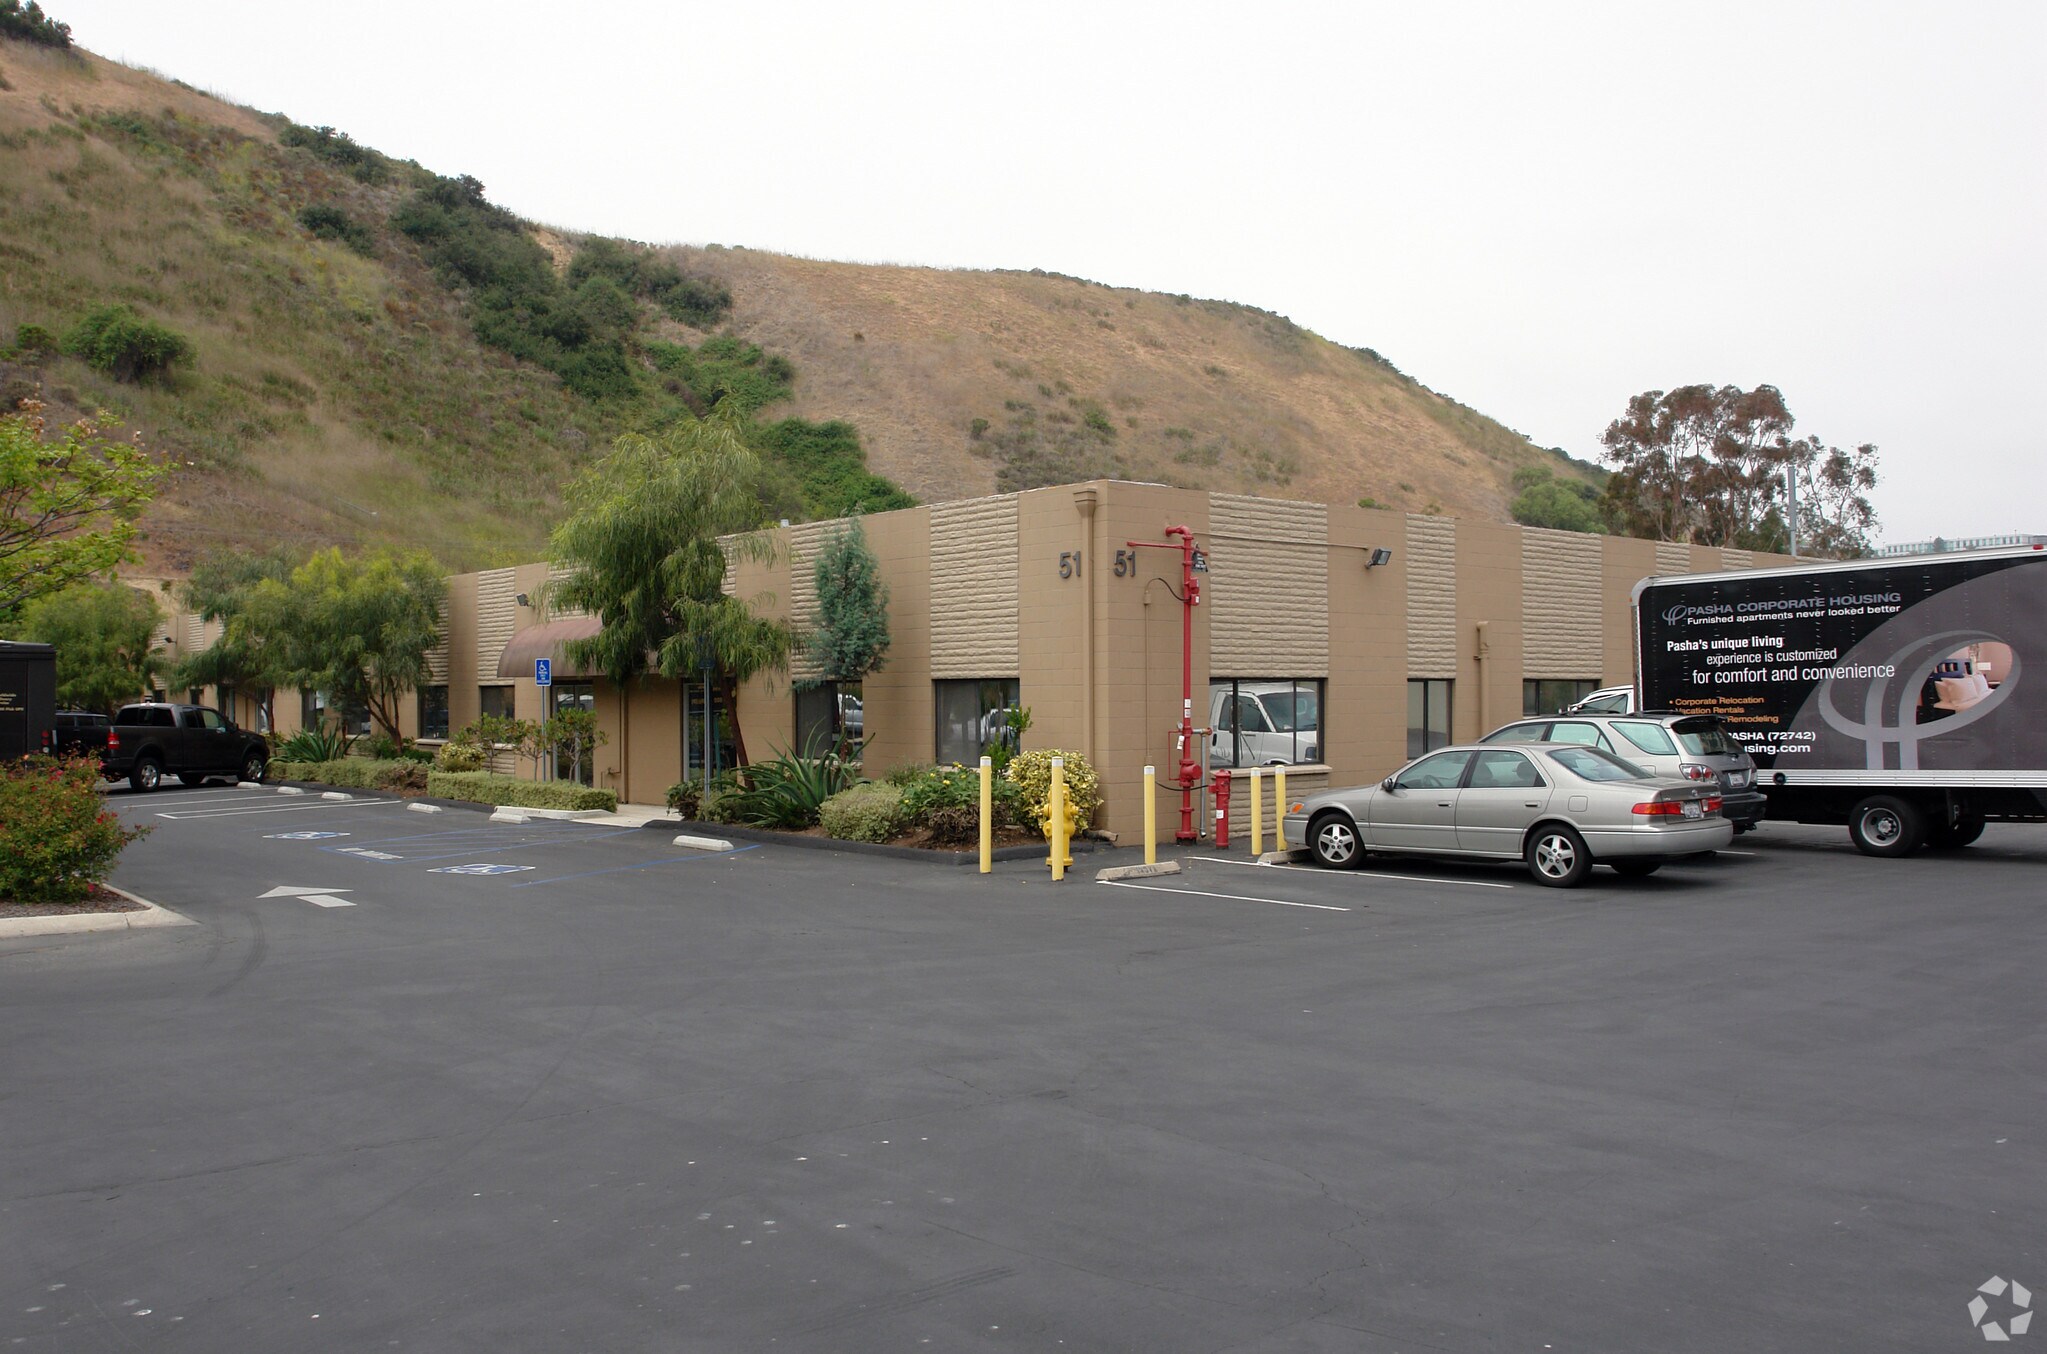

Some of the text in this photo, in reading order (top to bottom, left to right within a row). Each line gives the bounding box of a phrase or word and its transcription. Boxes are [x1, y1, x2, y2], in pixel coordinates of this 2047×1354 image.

[1059, 551, 1081, 578] 51
[1113, 550, 1136, 577] 51
[1687, 592, 1901, 616] PASHA CORPORATE HOUSING
[1687, 604, 1901, 625] Furnished apartments never looked better
[1667, 636, 1783, 652] Pasha's unique living
[1706, 648, 1837, 667] experience is customized
[1692, 663, 1895, 684] for comfort and convenience
[1675, 696, 1765, 707] Corporate Relocation
[1713, 706, 1745, 714] Rentals
[1727, 715, 1779, 724] Remodeling
[1728, 731, 1816, 742] ASHA (72742)
